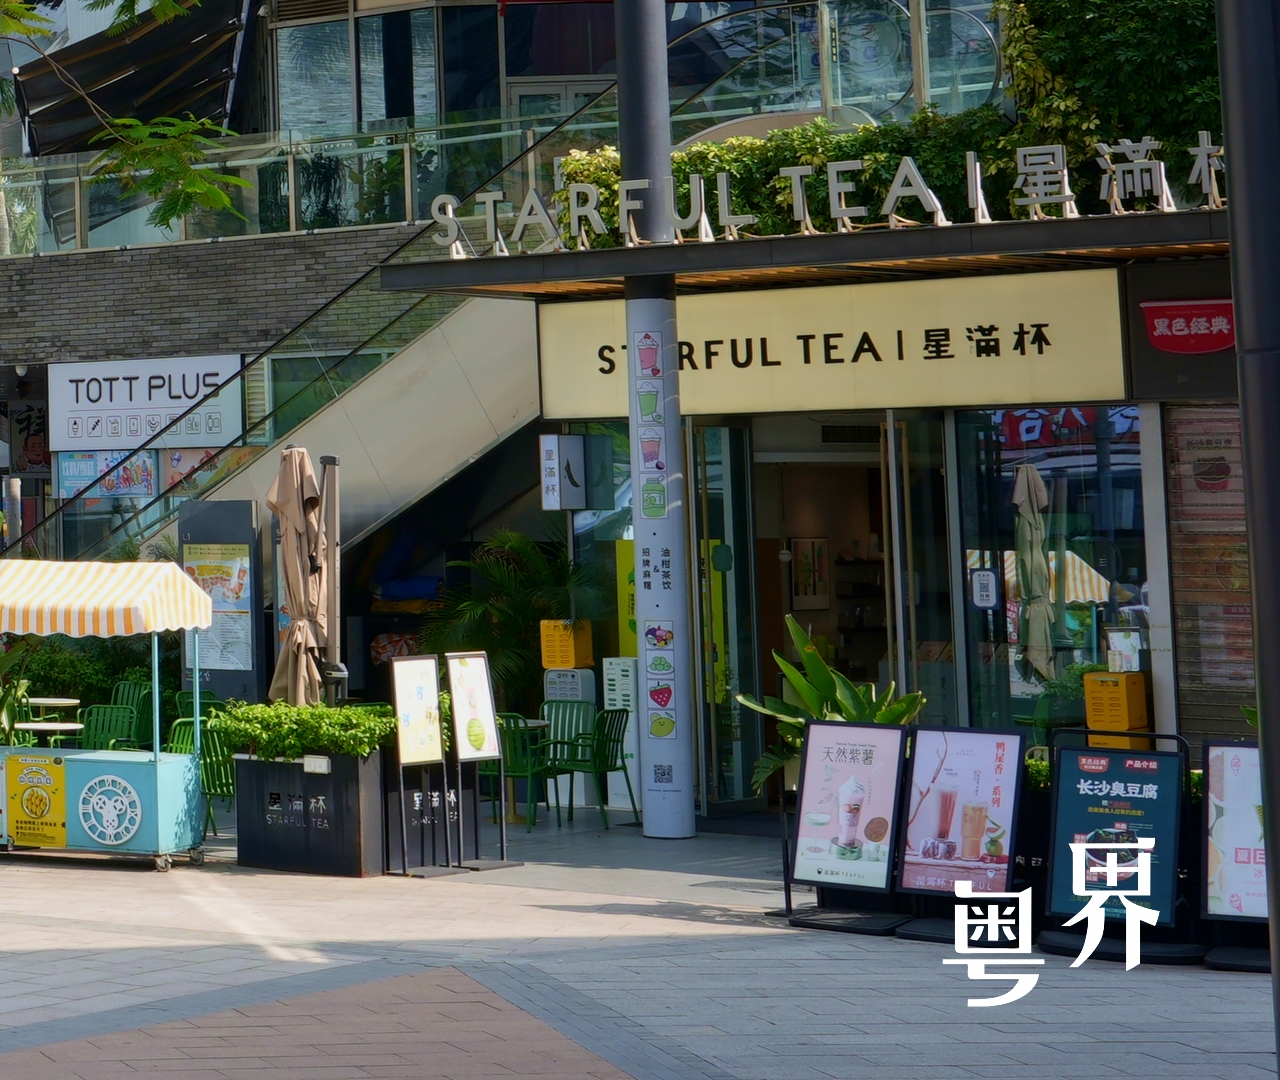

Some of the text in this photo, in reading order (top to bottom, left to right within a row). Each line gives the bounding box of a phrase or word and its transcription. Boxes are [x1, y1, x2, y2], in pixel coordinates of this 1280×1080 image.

[430, 172, 757, 247] STARFUL
[778, 156, 941, 221] TEA
[1153, 316, 1231, 336] 黑色经典
[597, 336, 782, 375] SRFUL
[796, 331, 883, 364] TEA
[68, 372, 220, 404] TOTT PLUS
[821, 746, 875, 766] 天然紫薯
[1125, 759, 1158, 769] 产品介绍
[1076, 778, 1159, 800] 长沙臭豆腐
[311, 818, 329, 830] TEA
[948, 879, 992, 891] TFUL
